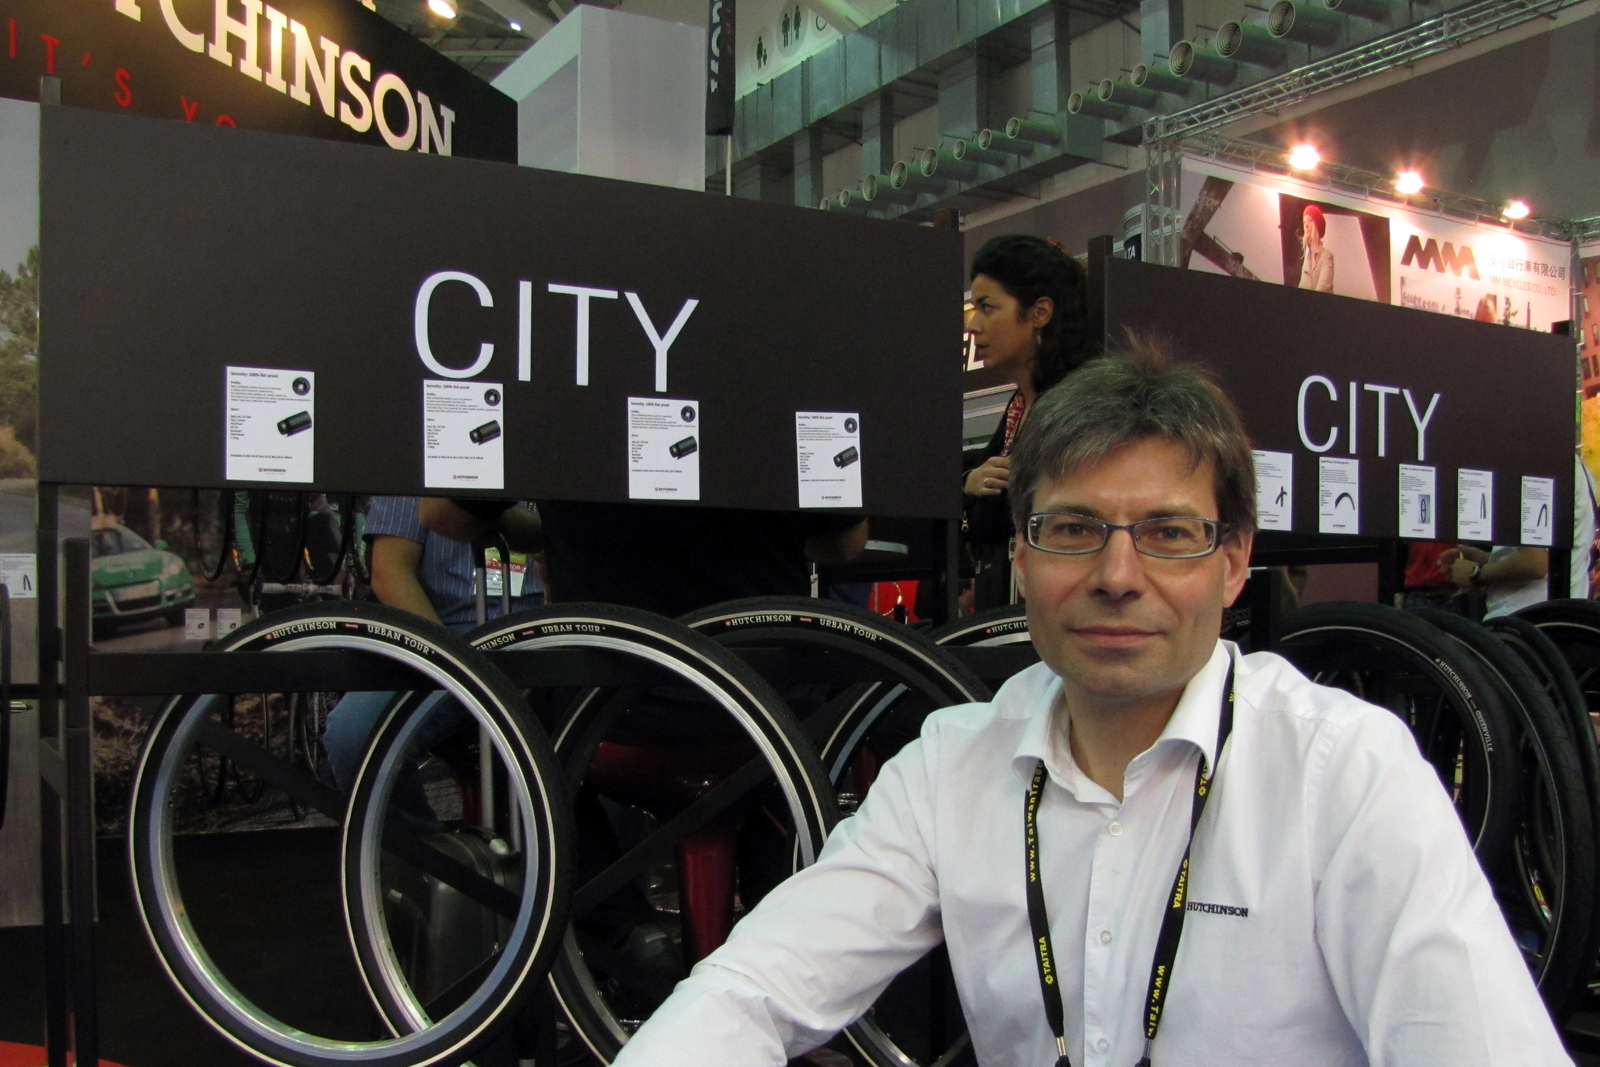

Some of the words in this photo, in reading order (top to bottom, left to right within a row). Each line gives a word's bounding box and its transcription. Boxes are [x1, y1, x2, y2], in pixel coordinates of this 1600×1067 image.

[9, 18, 132, 107] IT'S
[415, 270, 700, 392] CITY
[1297, 374, 1441, 461] CITY
[272, 621, 337, 639] HUTCHINSON
[366, 624, 402, 641] URBAN
[541, 624, 573, 634] URBAN
[731, 615, 793, 627] HUTCHINSON
[819, 618, 851, 632] URBAN
[1439, 661, 1472, 699] HUTCHINSON
[1172, 870, 1186, 908] TAITRA
[1186, 901, 1249, 918] HUTCHINSON
[1039, 936, 1051, 975] TAITRA
